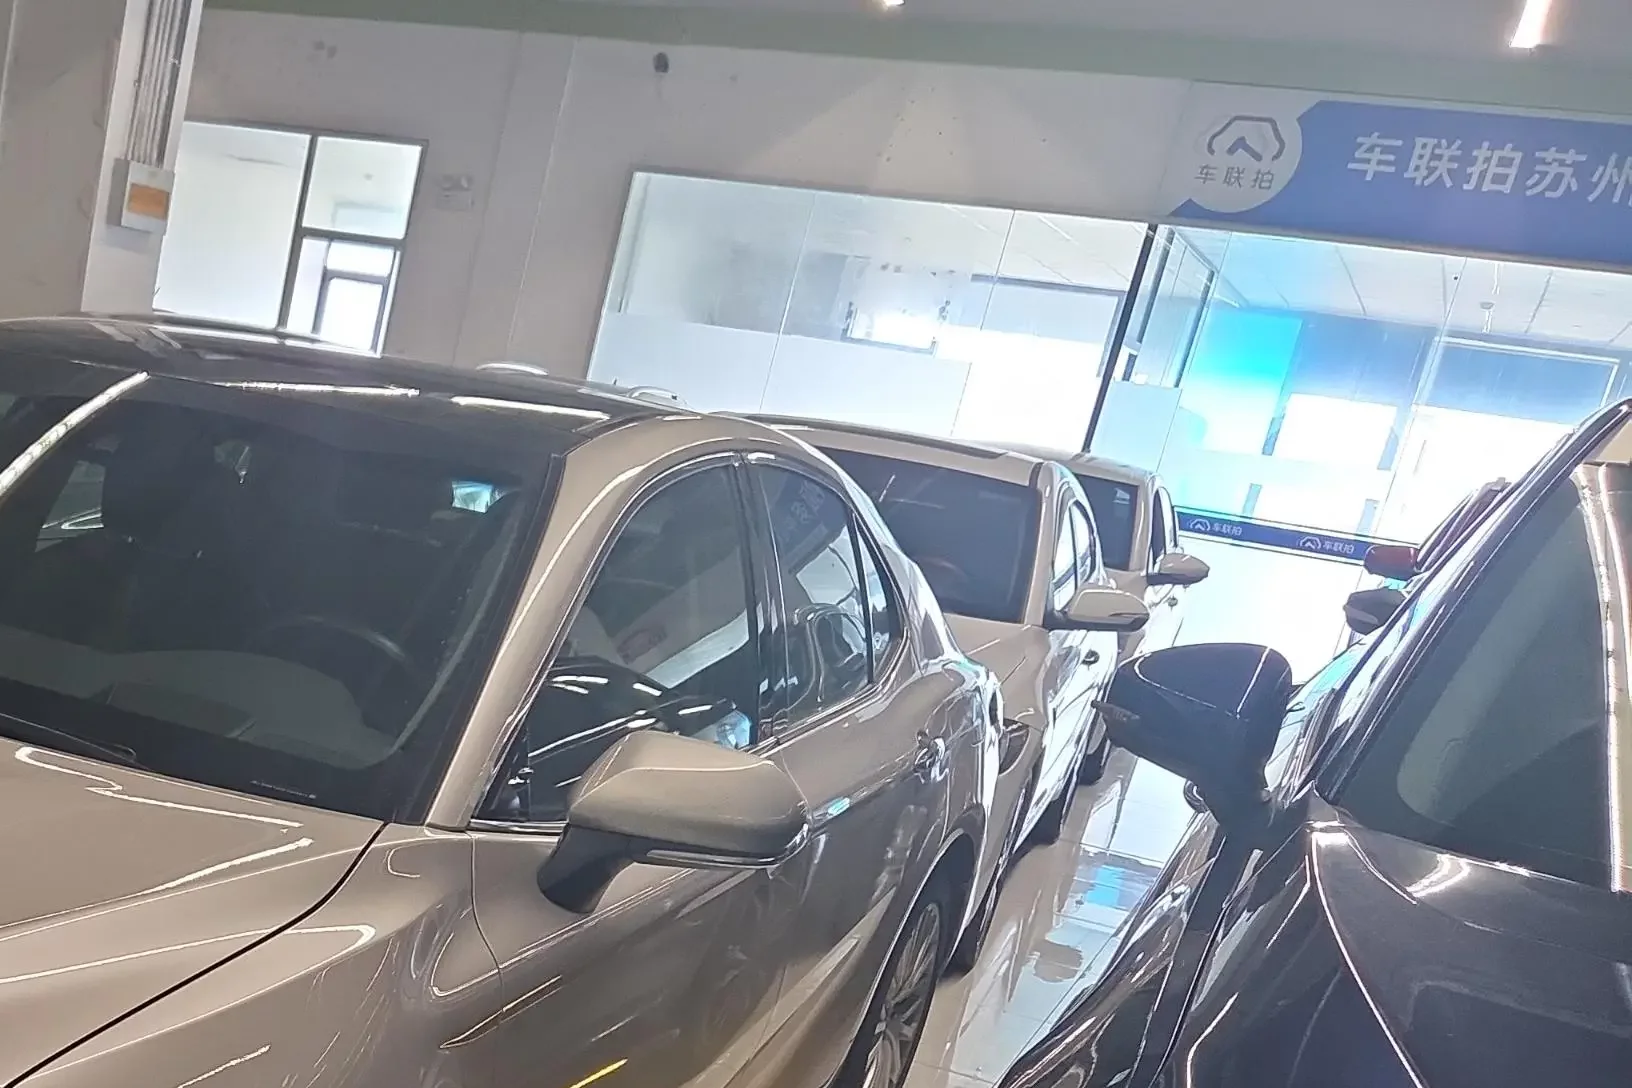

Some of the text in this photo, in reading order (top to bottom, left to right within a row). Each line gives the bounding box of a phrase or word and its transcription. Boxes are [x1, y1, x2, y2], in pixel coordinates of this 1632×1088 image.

[1194, 164, 1274, 190] 车联拍
[1212, 522, 1243, 537] 车联拍
[1322, 540, 1355, 555] 车联拍
